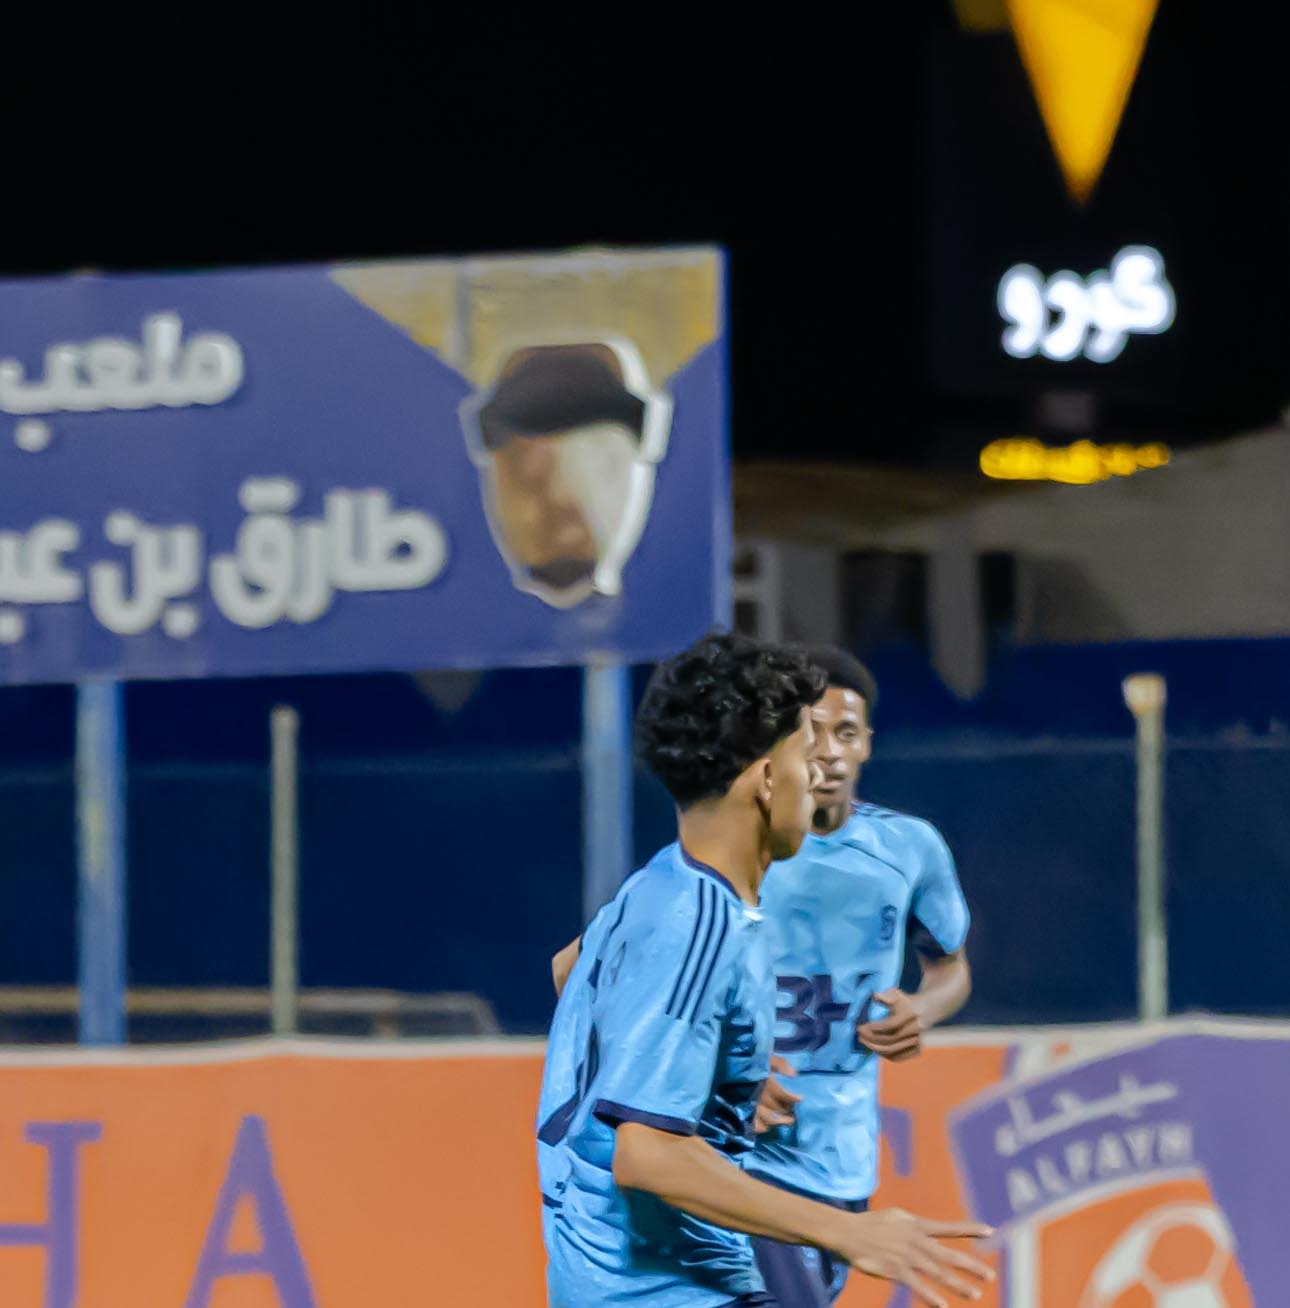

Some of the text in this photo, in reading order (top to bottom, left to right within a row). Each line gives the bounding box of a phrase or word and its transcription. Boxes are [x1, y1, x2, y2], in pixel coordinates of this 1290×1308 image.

[0, 312, 244, 452] ملعب
[0, 478, 446, 644] طارق بن عب
